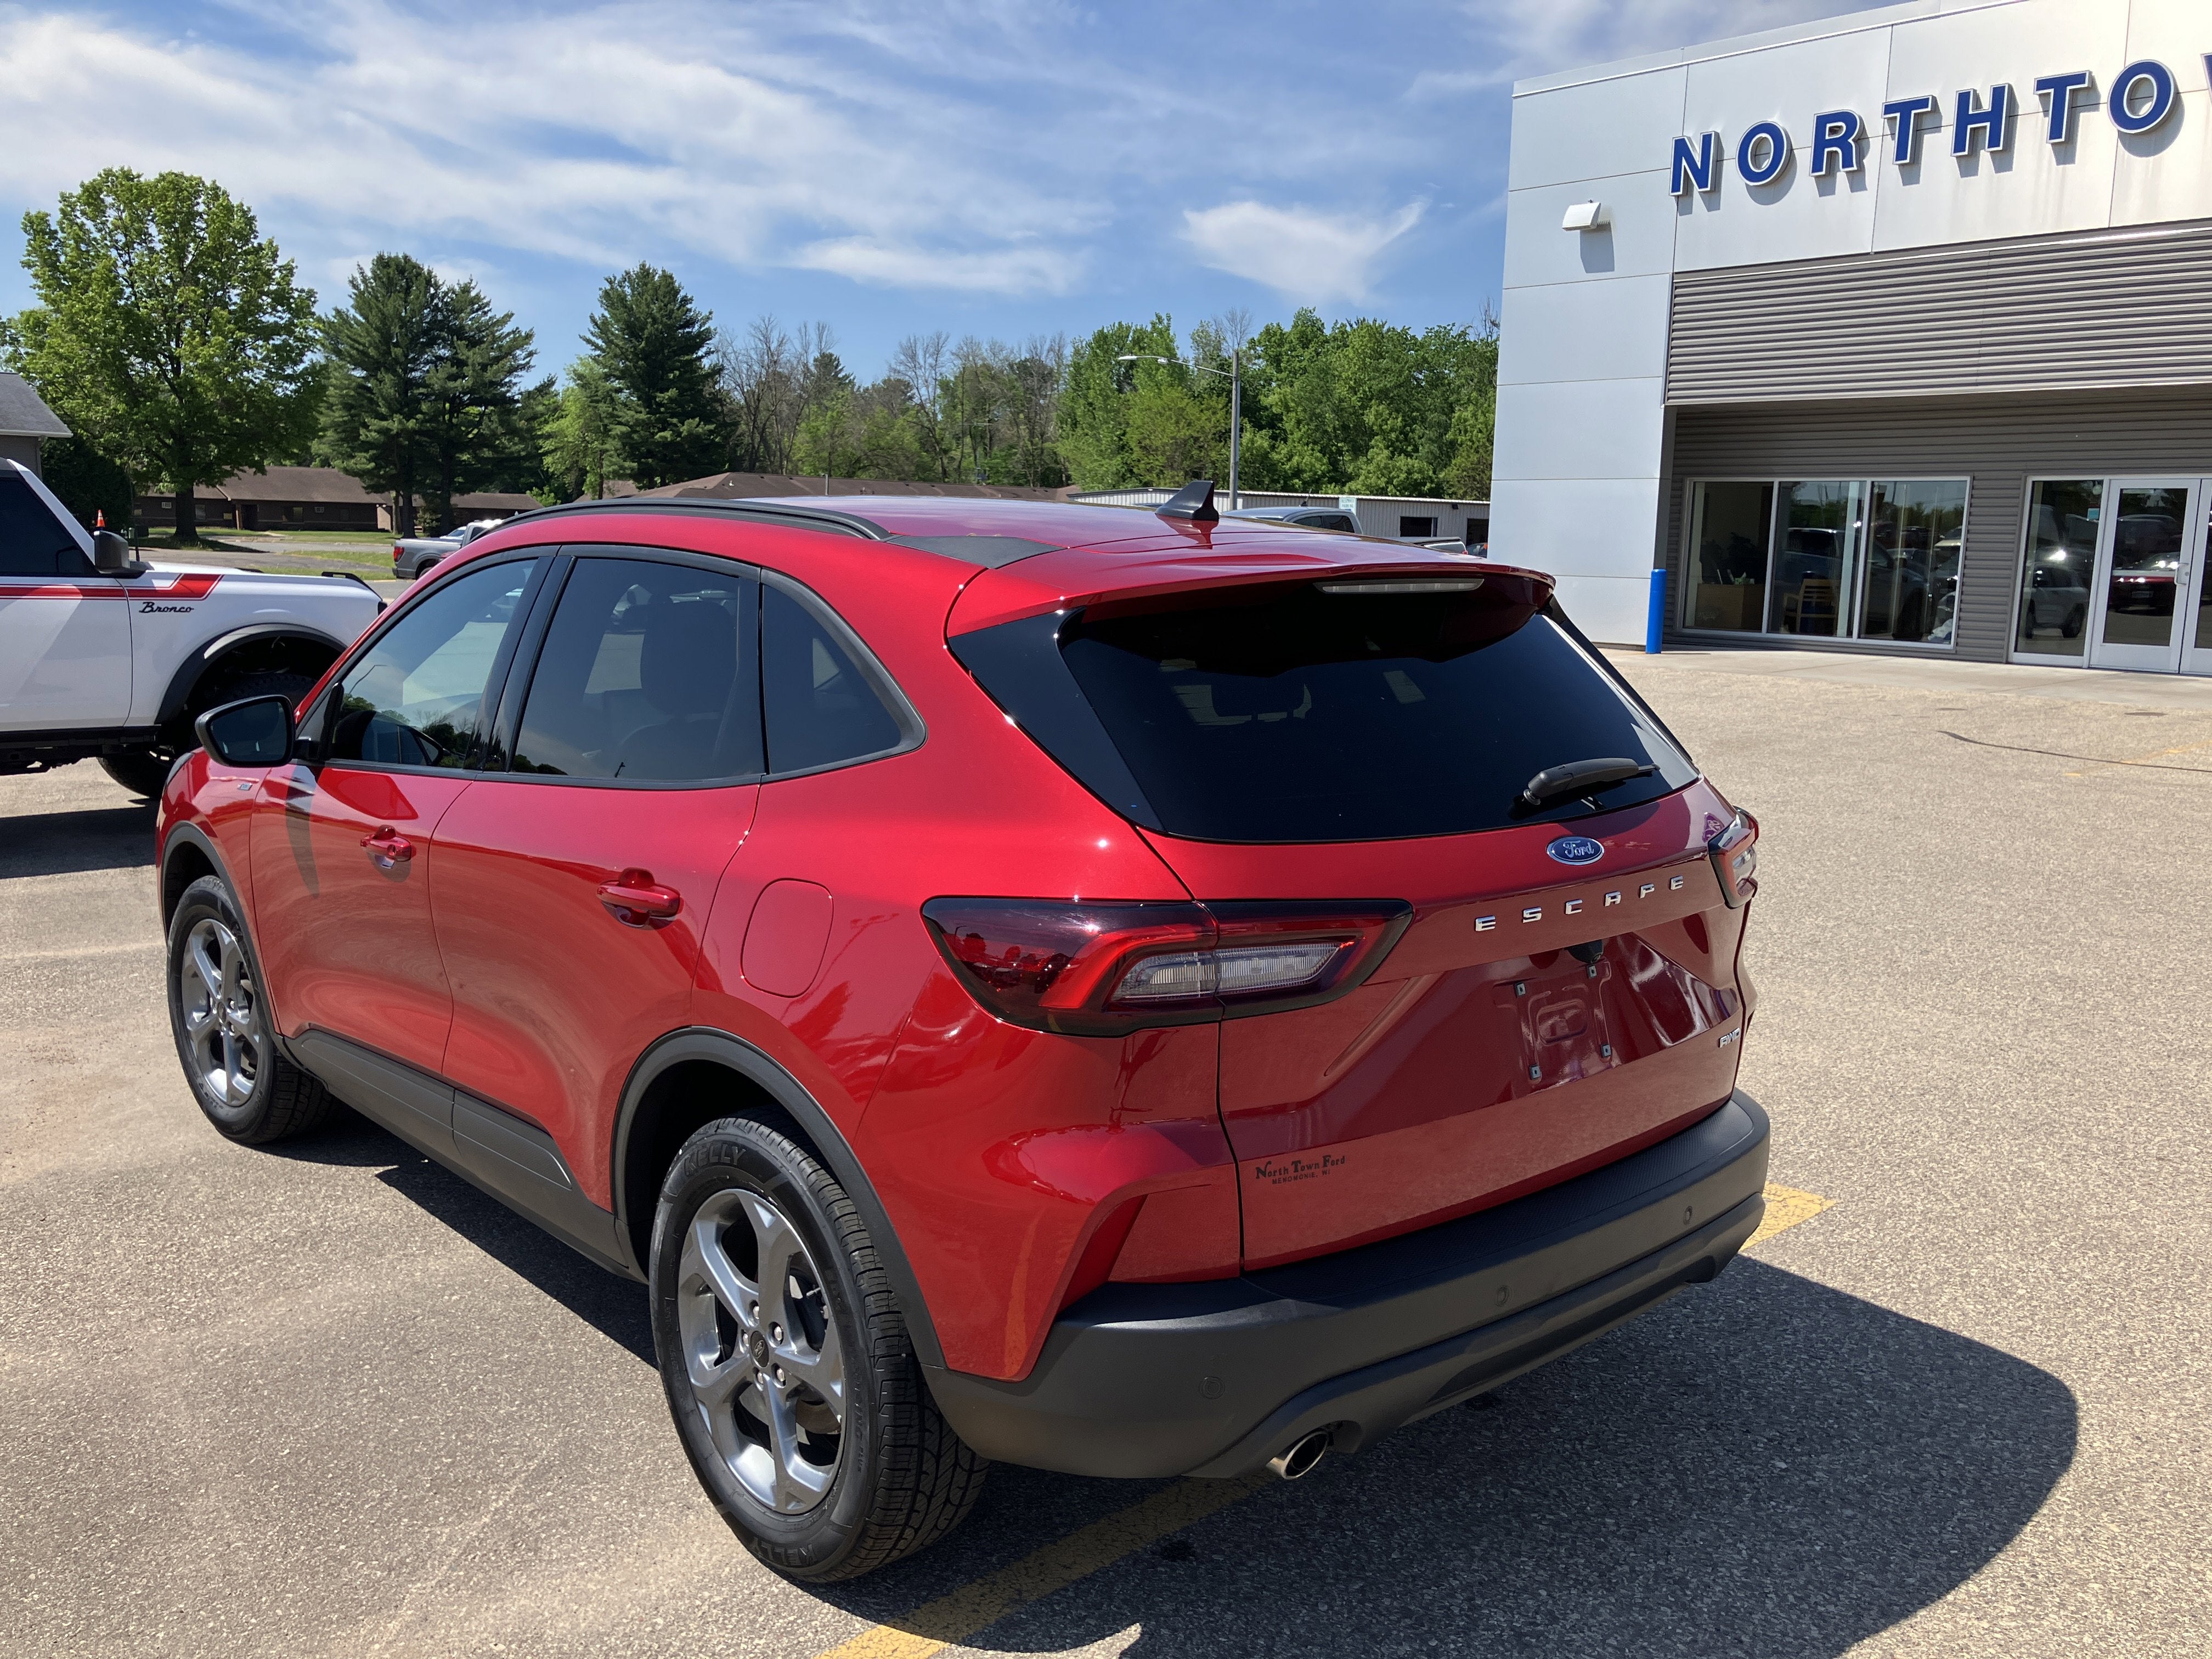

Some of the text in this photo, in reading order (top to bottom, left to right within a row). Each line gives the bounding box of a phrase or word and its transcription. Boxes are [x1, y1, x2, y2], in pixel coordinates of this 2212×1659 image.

[1669, 55, 2212, 196] NORTHTO
[139, 601, 194, 613] Bronco
[1563, 840, 1594, 858] Ford
[1475, 876, 1684, 932] ESCAPE
[1719, 1028, 1740, 1048] AWD
[684, 1141, 746, 1176] KELLY
[1255, 1154, 1345, 1180] North Town Ford
